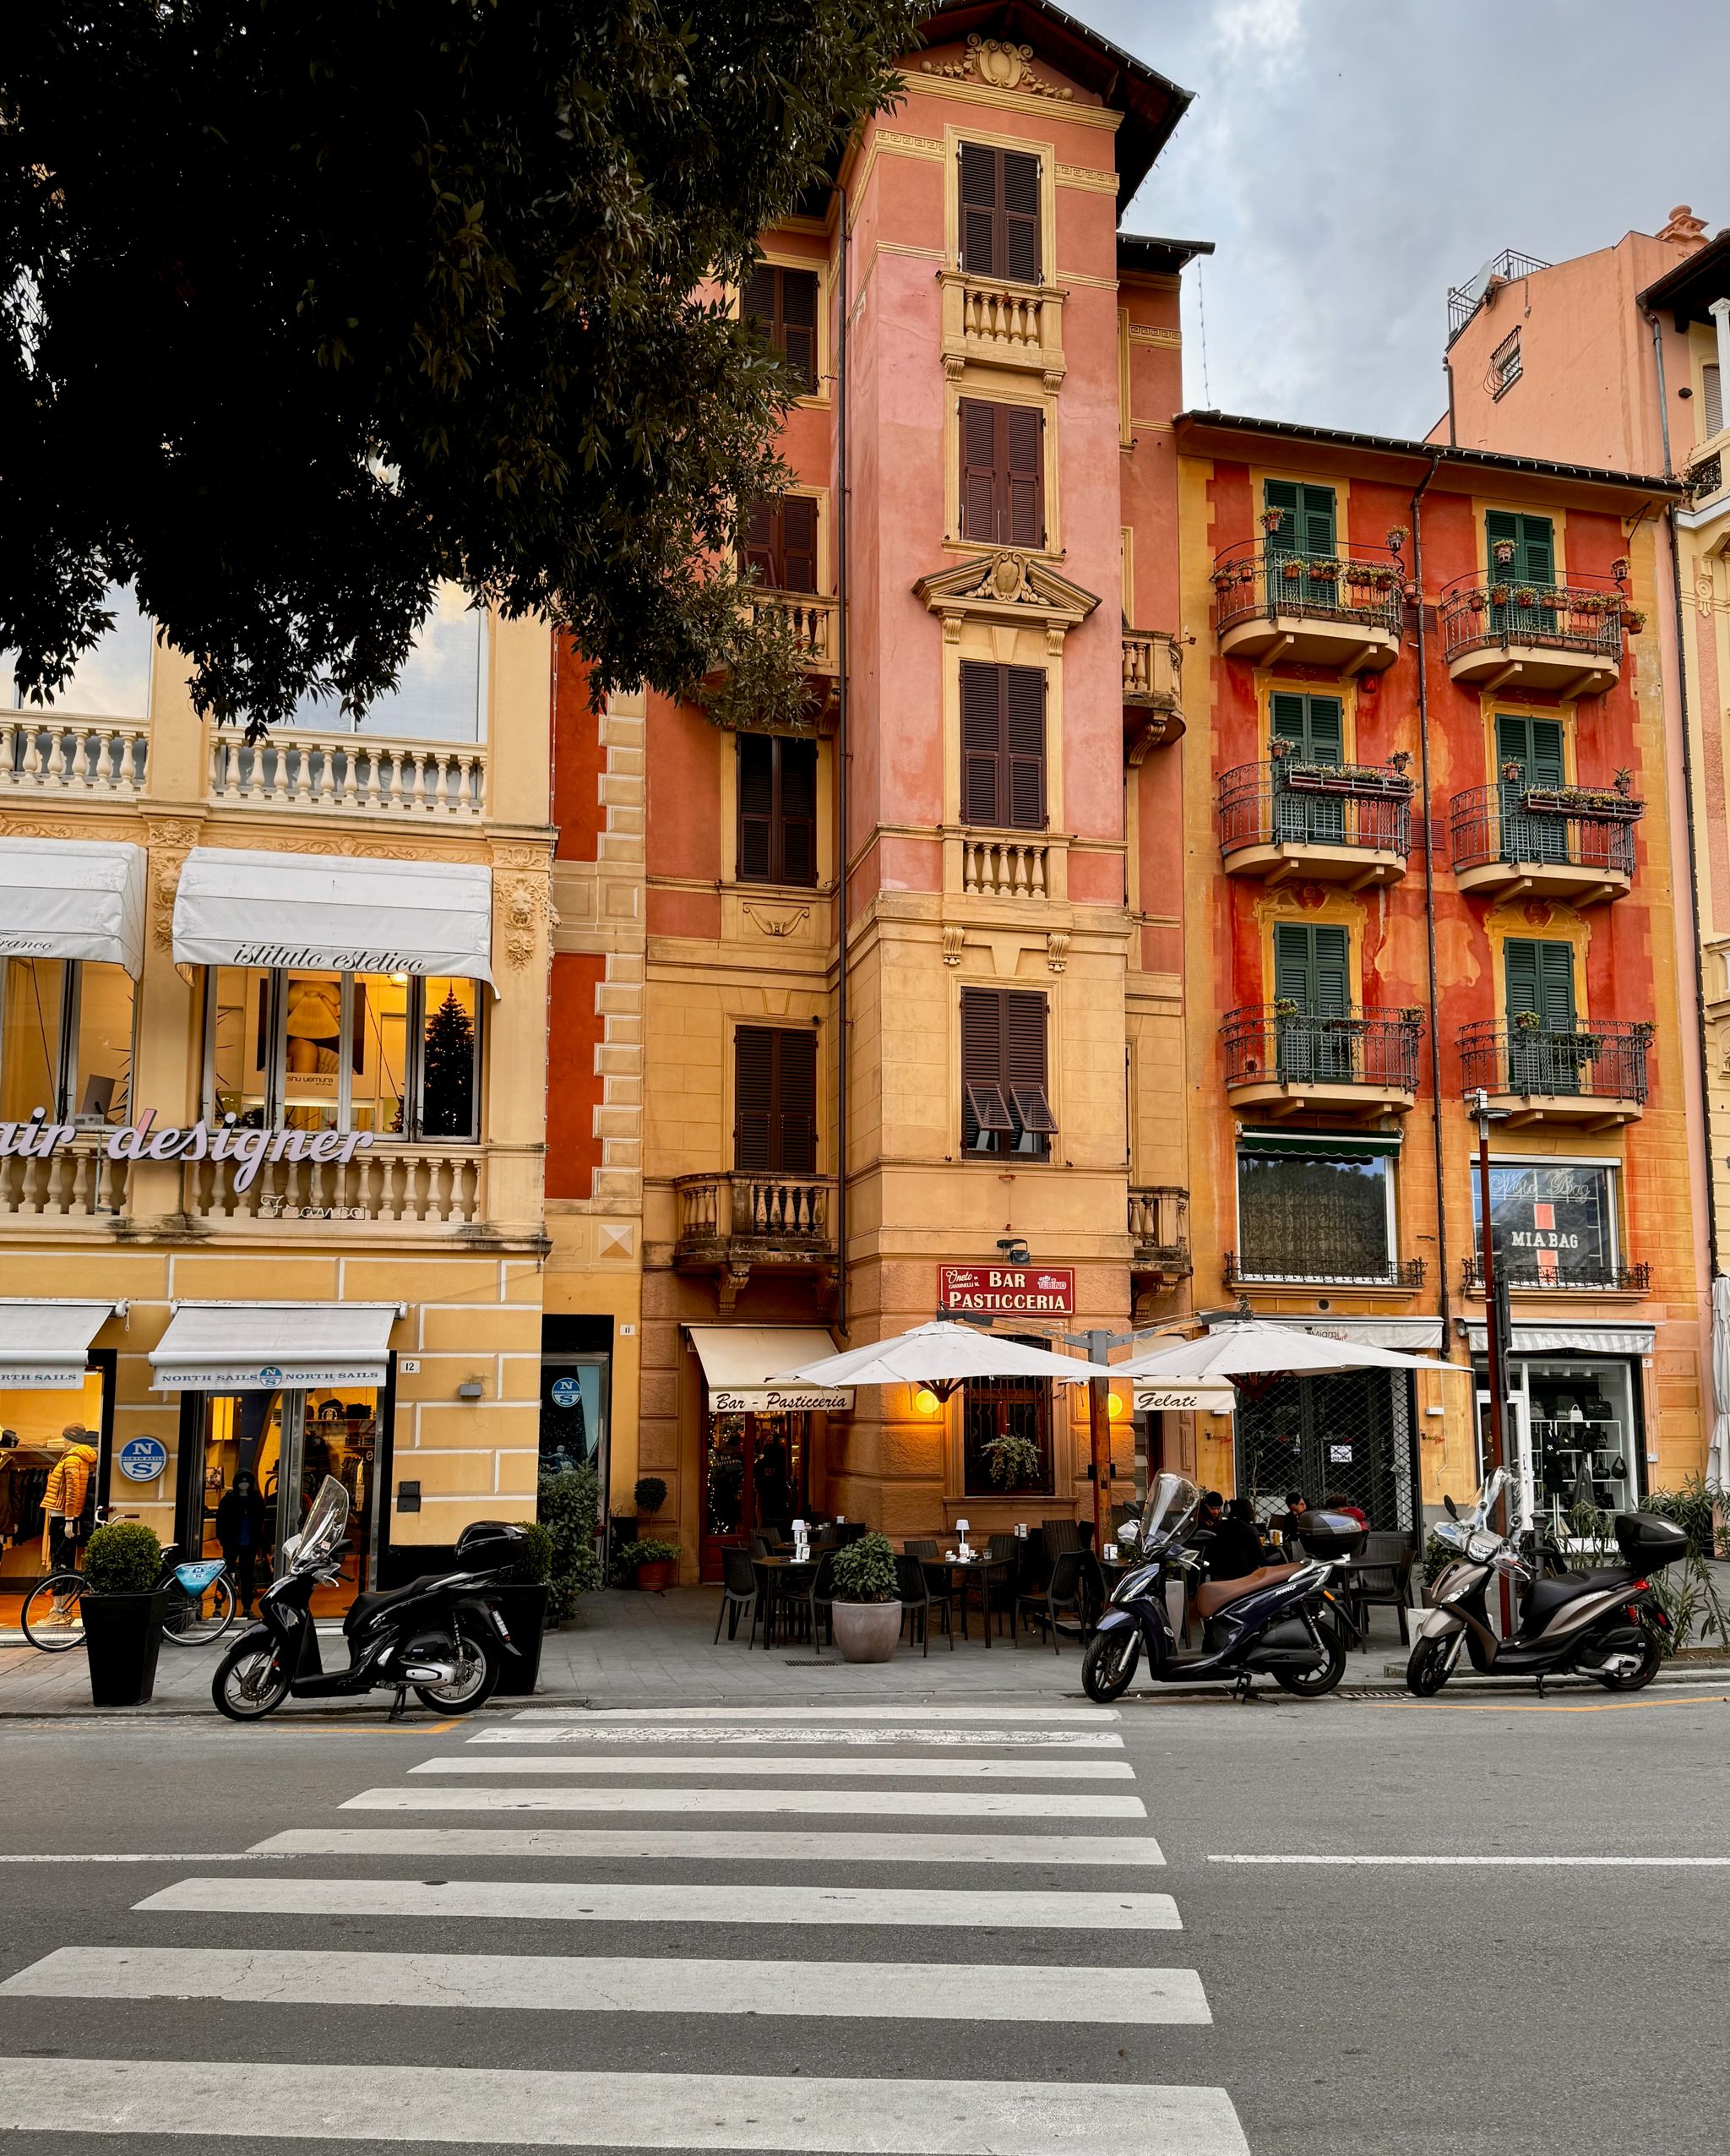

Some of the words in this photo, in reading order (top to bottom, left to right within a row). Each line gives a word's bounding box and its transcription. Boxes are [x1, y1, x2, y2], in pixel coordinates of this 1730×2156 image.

[0, 932, 52, 950] ranco
[233, 944, 324, 968] istituto
[333, 950, 426, 972] estetico
[107, 1108, 374, 1193] designer
[1547, 1168, 1590, 1204] Bag
[1511, 1231, 1546, 1248] MIA
[1548, 1233, 1579, 1249] BAG
[989, 1271, 1025, 1288] BAR
[1037, 1279, 1067, 1290] TUBINO
[949, 1291, 1066, 1310] PASTICCERIA
[405, 1362, 415, 1371] 12
[559, 1380, 574, 1390] N
[559, 1395, 573, 1403] S
[716, 1393, 745, 1410] Bar
[766, 1391, 847, 1409] Pasticceria
[1138, 1392, 1198, 1409] Gelati
[132, 1442, 155, 1455] N
[132, 1462, 153, 1475] S
